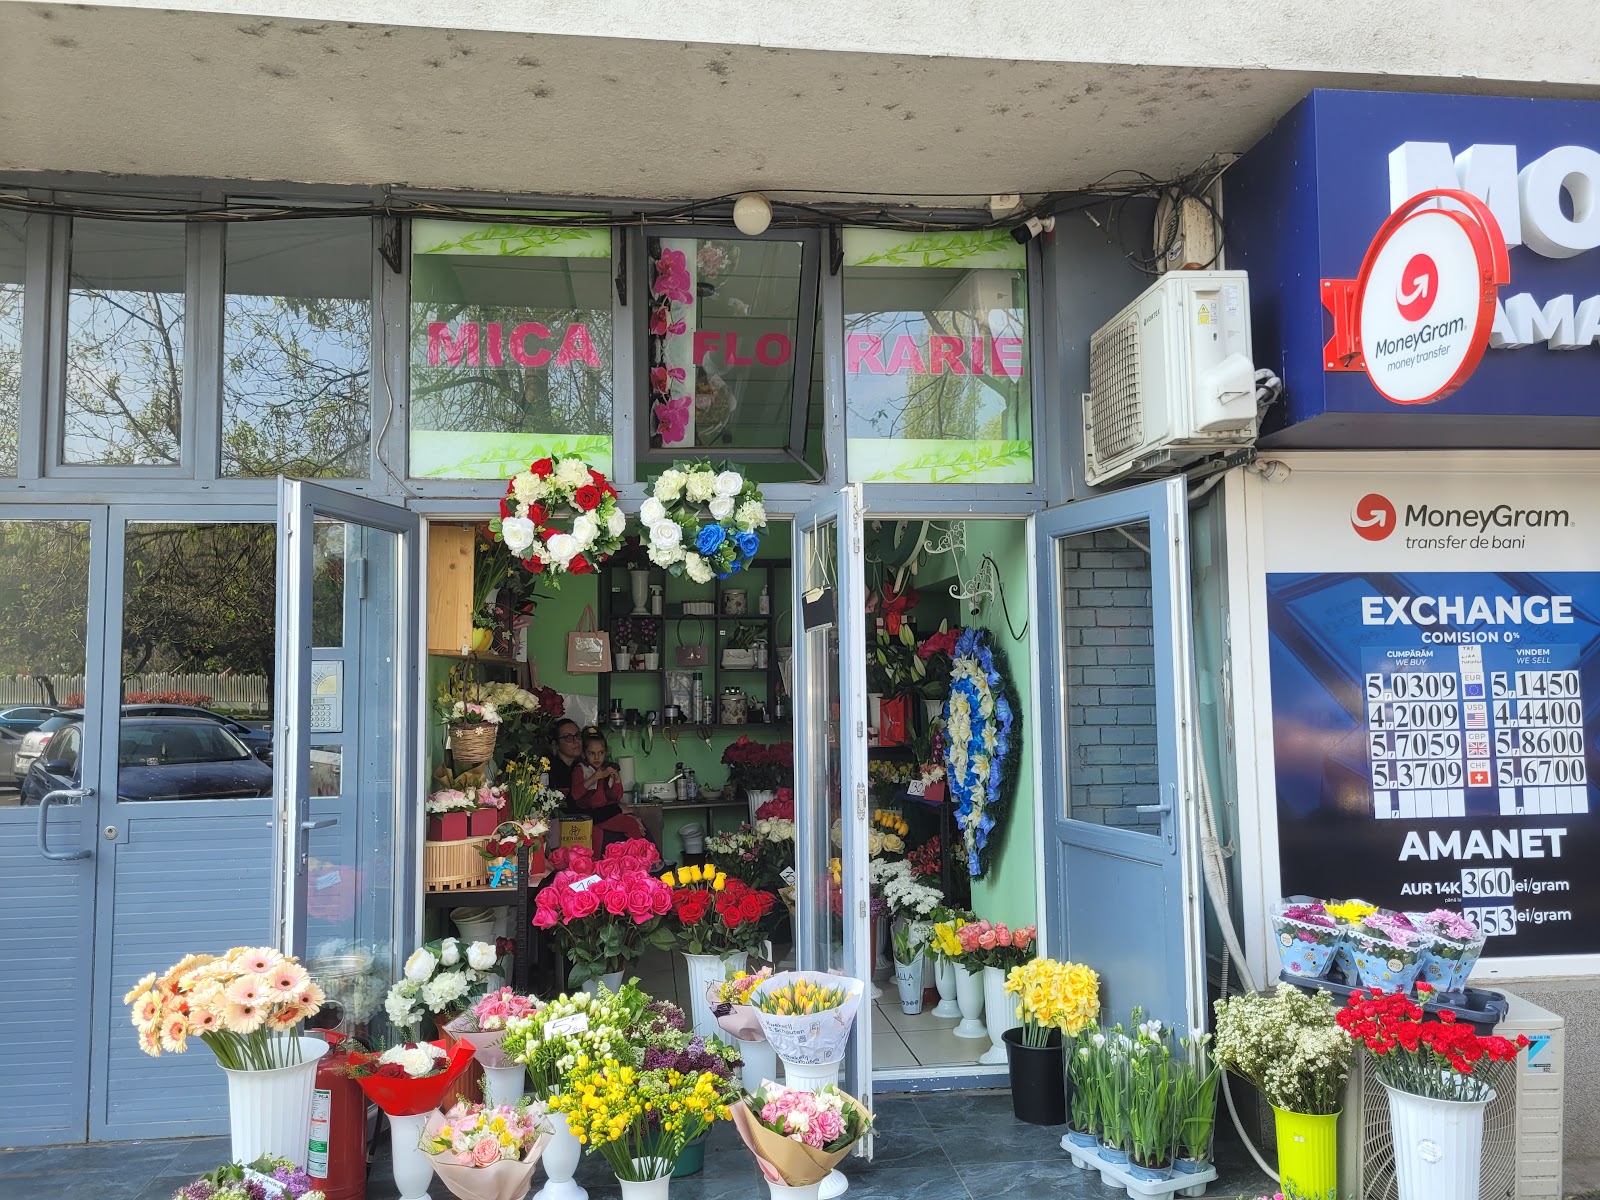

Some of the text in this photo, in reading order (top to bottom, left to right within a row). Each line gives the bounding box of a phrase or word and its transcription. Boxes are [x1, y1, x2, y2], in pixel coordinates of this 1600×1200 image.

[427, 321, 1024, 377] MICA FLO RARIE
[1375, 317, 1464, 359] MoneyGram
[1387, 344, 1450, 372] money transfer
[1404, 504, 1569, 533] MoneyGram
[1406, 535, 1526, 548] transfer de bani
[1361, 595, 1574, 625] EXCHANGE
[1421, 631, 1520, 643] COMISION 0%
[1386, 648, 1434, 658] CUMPĂRĂM
[1395, 658, 1427, 666] WE BUY
[1516, 648, 1550, 656] VINDEM
[1368, 675, 1456, 699] 5,0309
[1493, 673, 1578, 698] 5,1450
[1370, 704, 1458, 729] 4,2009
[1495, 702, 1581, 726] 4,4400
[1372, 733, 1460, 758] 5,7059
[1497, 730, 1583, 755] 5,8600
[1373, 762, 1462, 787] 5,3709
[1499, 759, 1585, 784] 5,6700
[1398, 828, 1568, 861] AMANET
[1400, 870, 1570, 896] AUR 14K 360 lei/gram
[1466, 907, 1572, 933] 353 lei/gram
